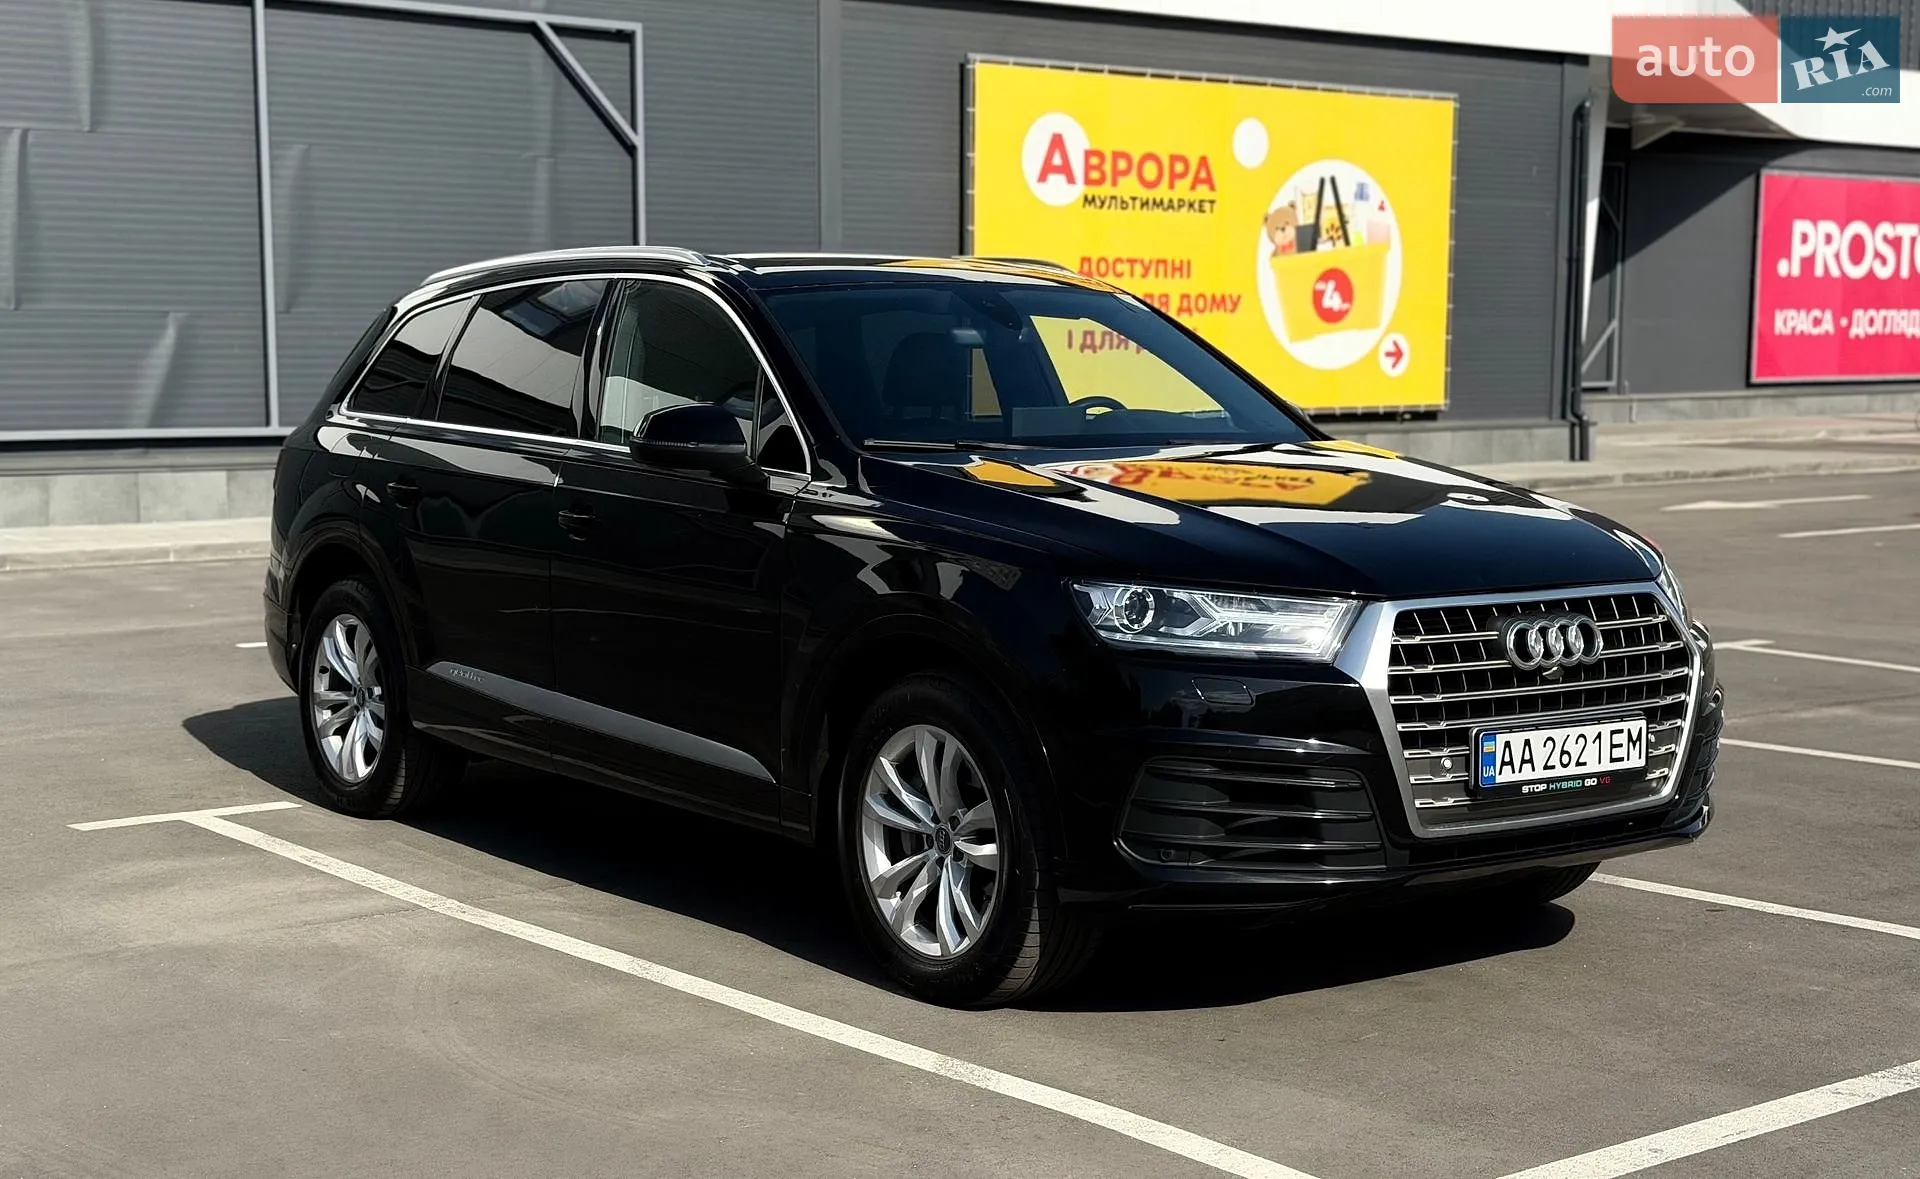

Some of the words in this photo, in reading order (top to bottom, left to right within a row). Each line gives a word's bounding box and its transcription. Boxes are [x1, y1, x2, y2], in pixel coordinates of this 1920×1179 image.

[1037, 132, 1217, 193] АВРОРА
[1082, 194, 1217, 214] МУЛЬТИМАРКЕТ
[1776, 218, 1920, 280] .PROST
[1078, 256, 1192, 279] ДОСТУПНІ
[1176, 293, 1242, 317] ДОМУ
[1774, 308, 1835, 336] КРАСА
[1542, 731, 1602, 771] 2621
[1483, 766, 1495, 777] UA
[1521, 783, 1547, 794] STOP
[1549, 780, 1583, 791] HYBRID
[1584, 777, 1598, 787] GO
